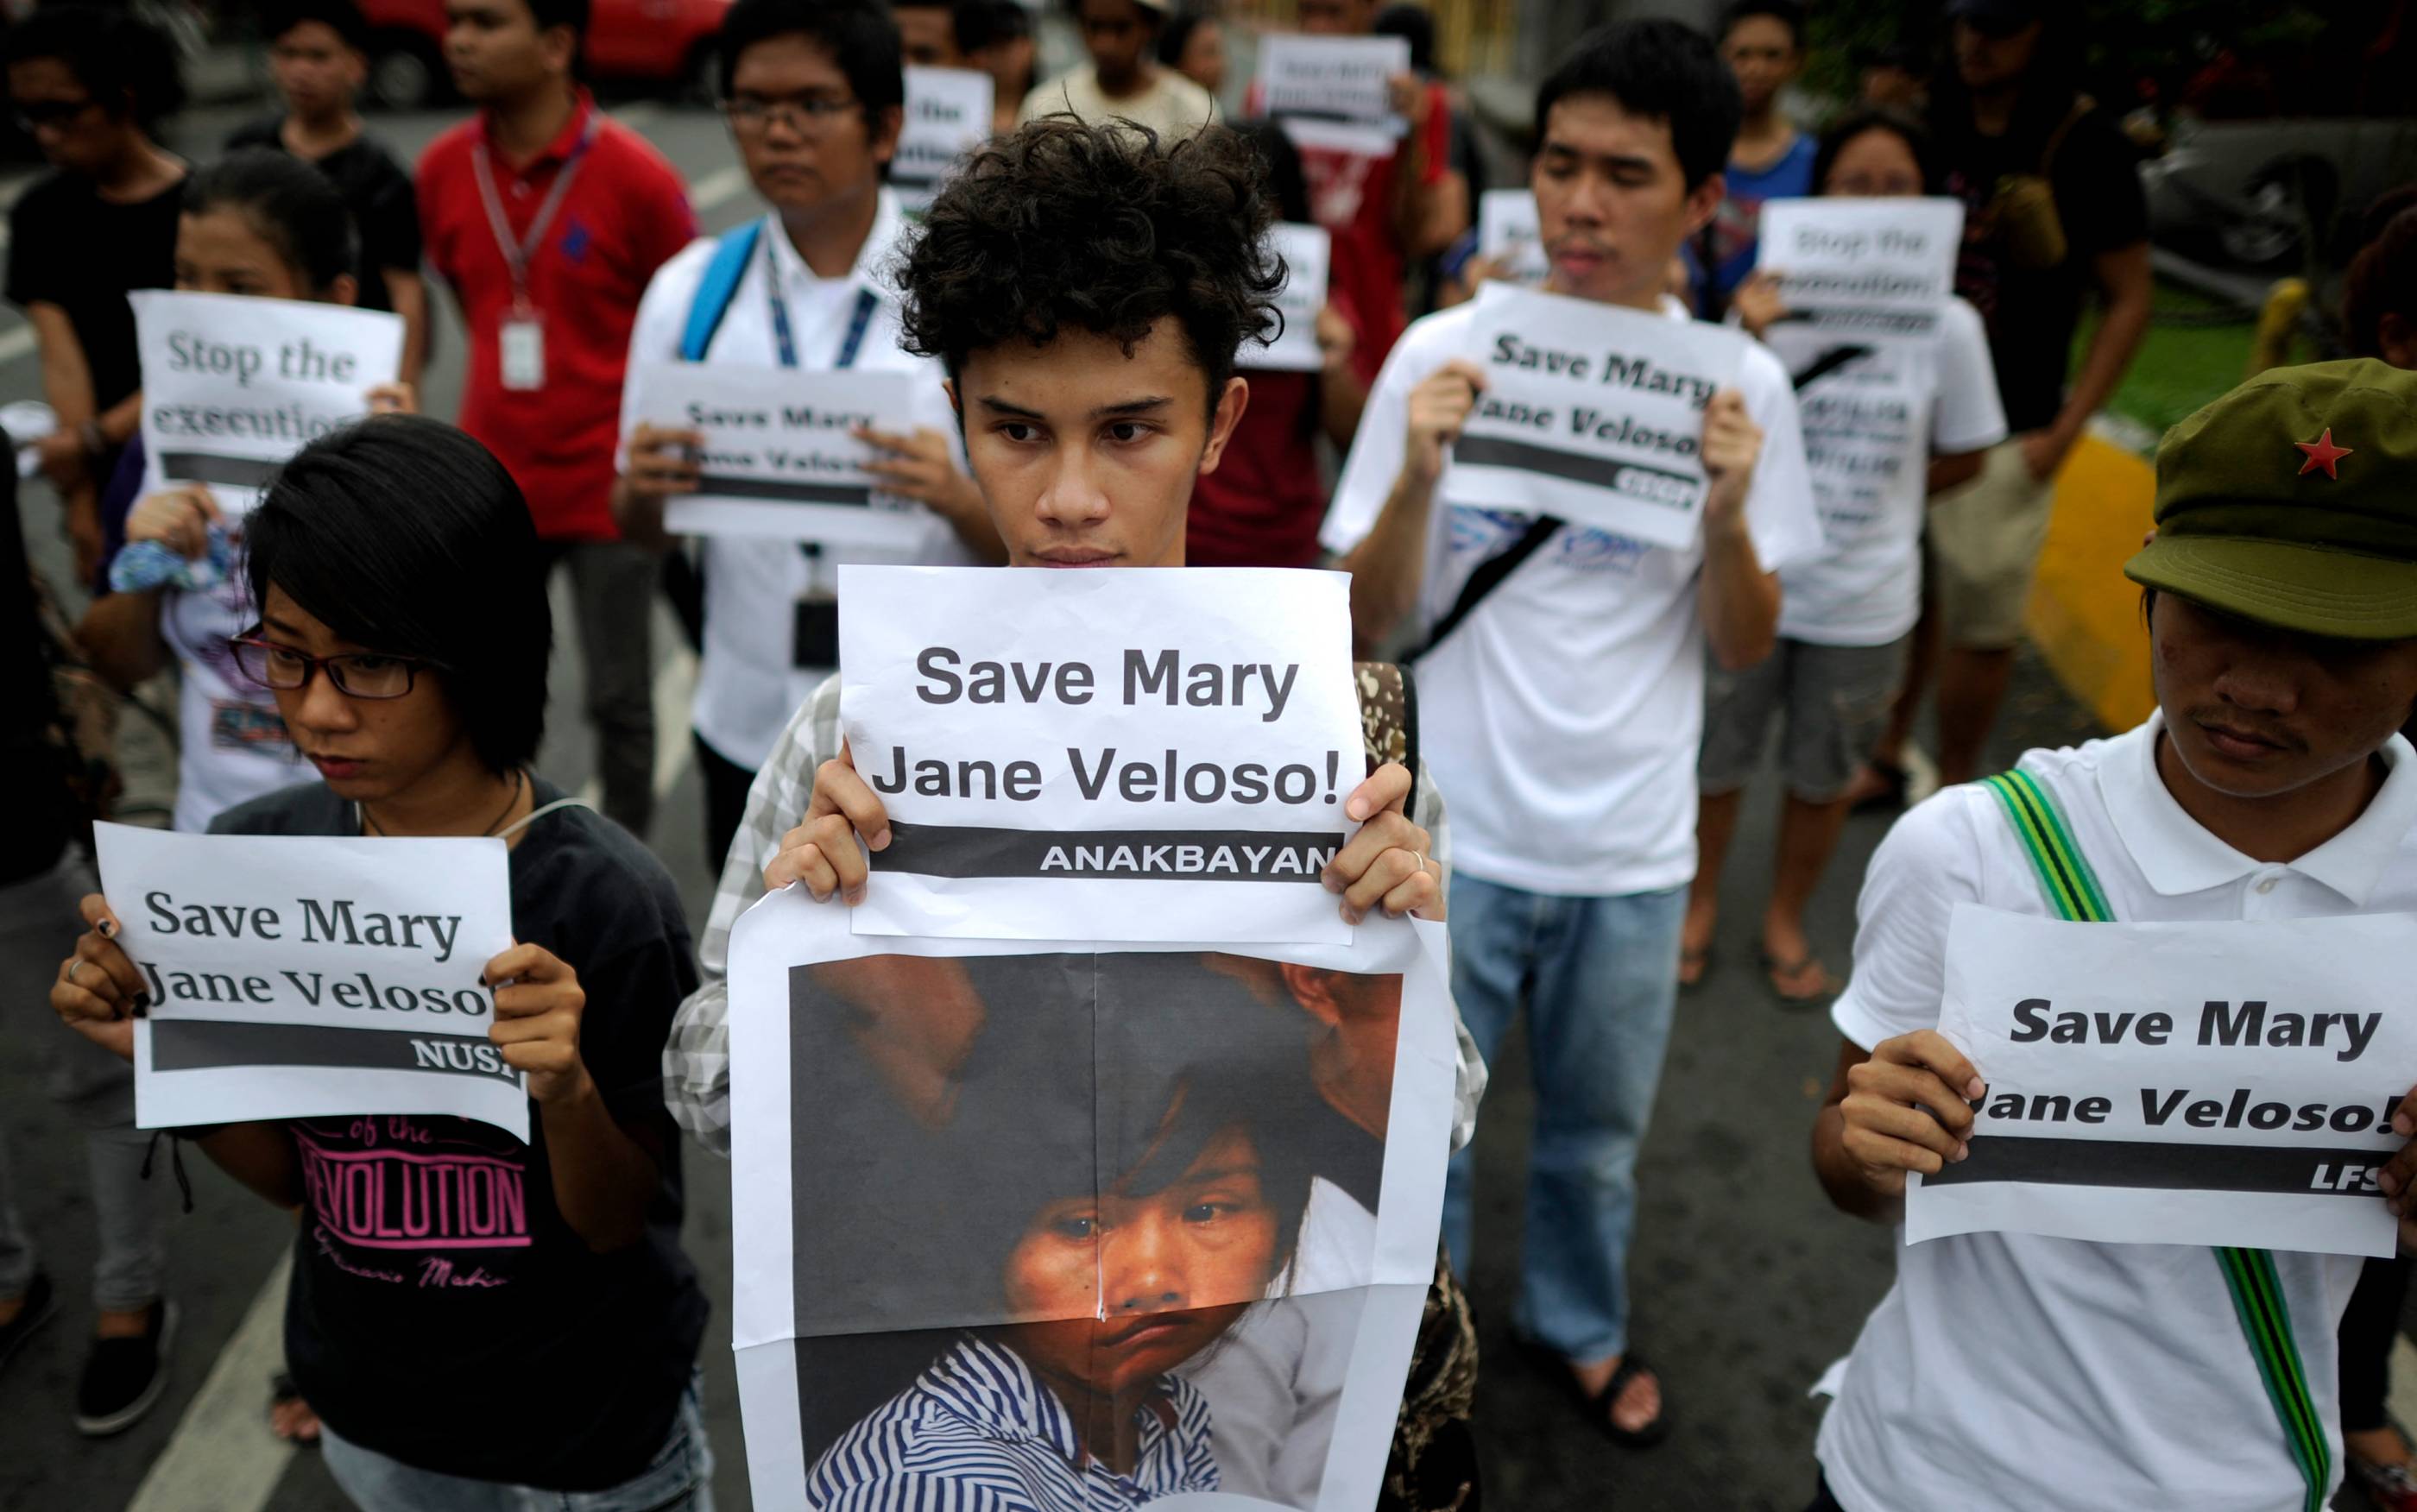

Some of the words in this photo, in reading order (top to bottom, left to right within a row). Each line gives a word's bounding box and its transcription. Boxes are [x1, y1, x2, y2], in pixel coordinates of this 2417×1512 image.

[167, 331, 259, 388] Stop
[279, 335, 356, 382] the
[1492, 333, 1590, 380] Save
[1603, 352, 1720, 409] Mary
[151, 402, 341, 439] executio
[687, 402, 770, 429] Save
[1474, 397, 1555, 429] ane
[1570, 406, 1698, 457] Veloso
[697, 452, 754, 467] ane
[915, 646, 1095, 706] Save
[1123, 649, 1300, 722] Mary
[871, 746, 1043, 802] Jane
[1067, 747, 1340, 805] Veloso!
[1040, 844, 1336, 875] ANAKBAYAN
[144, 891, 281, 941] Save
[296, 898, 463, 963] Mary
[138, 961, 275, 1007] Jane
[280, 969, 495, 1017] Veloso
[2009, 998, 2174, 1046] Save
[2196, 999, 2383, 1063] Mary
[350, 1116, 377, 1147] of
[388, 1116, 432, 1143] the
[2139, 1087, 2406, 1135] Veloso!
[2310, 1164, 2381, 1192] LFS
